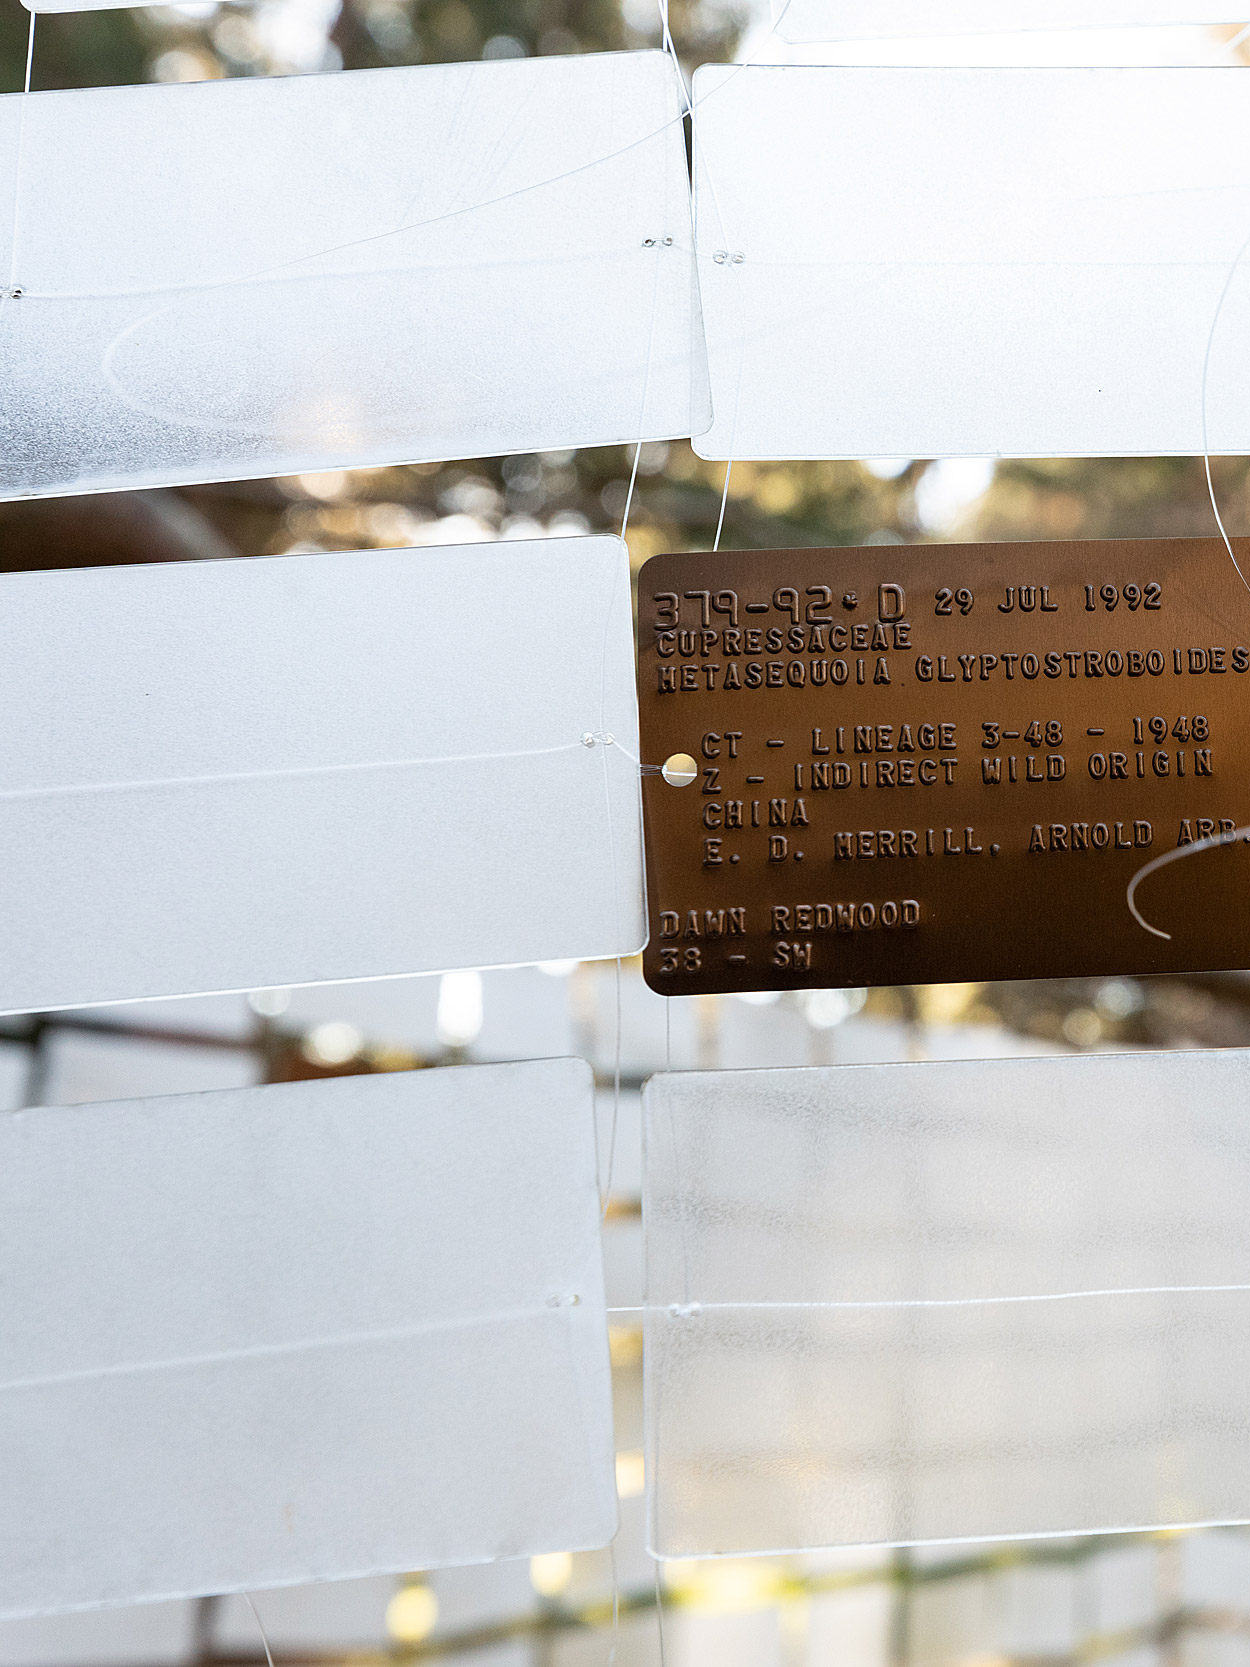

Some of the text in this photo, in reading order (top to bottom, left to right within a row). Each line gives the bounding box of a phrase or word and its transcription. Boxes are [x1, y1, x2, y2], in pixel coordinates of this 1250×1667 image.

[934, 588, 975, 616] 29
[997, 586, 1058, 613] JUL
[1084, 582, 1163, 612] 1992
[656, 622, 912, 658] CUPRESSACEAE
[657, 646, 1250, 694] METASEQUOIA GLYPTOSTROBOIDES
[702, 715, 1211, 758] CT - LINEAGE 3-48 - 1948
[702, 749, 1214, 794] Z - INDIRECT WILD ORIGIN
[702, 798, 810, 829] CHINA
[702, 837, 741, 866] E.
[768, 834, 805, 862] D.
[833, 826, 1000, 860] MERRILL,
[1028, 819, 1153, 853] ARNOLD
[658, 899, 921, 939] DAWN REDWOOD
[658, 947, 702, 976] 38
[772, 941, 812, 970] SW
